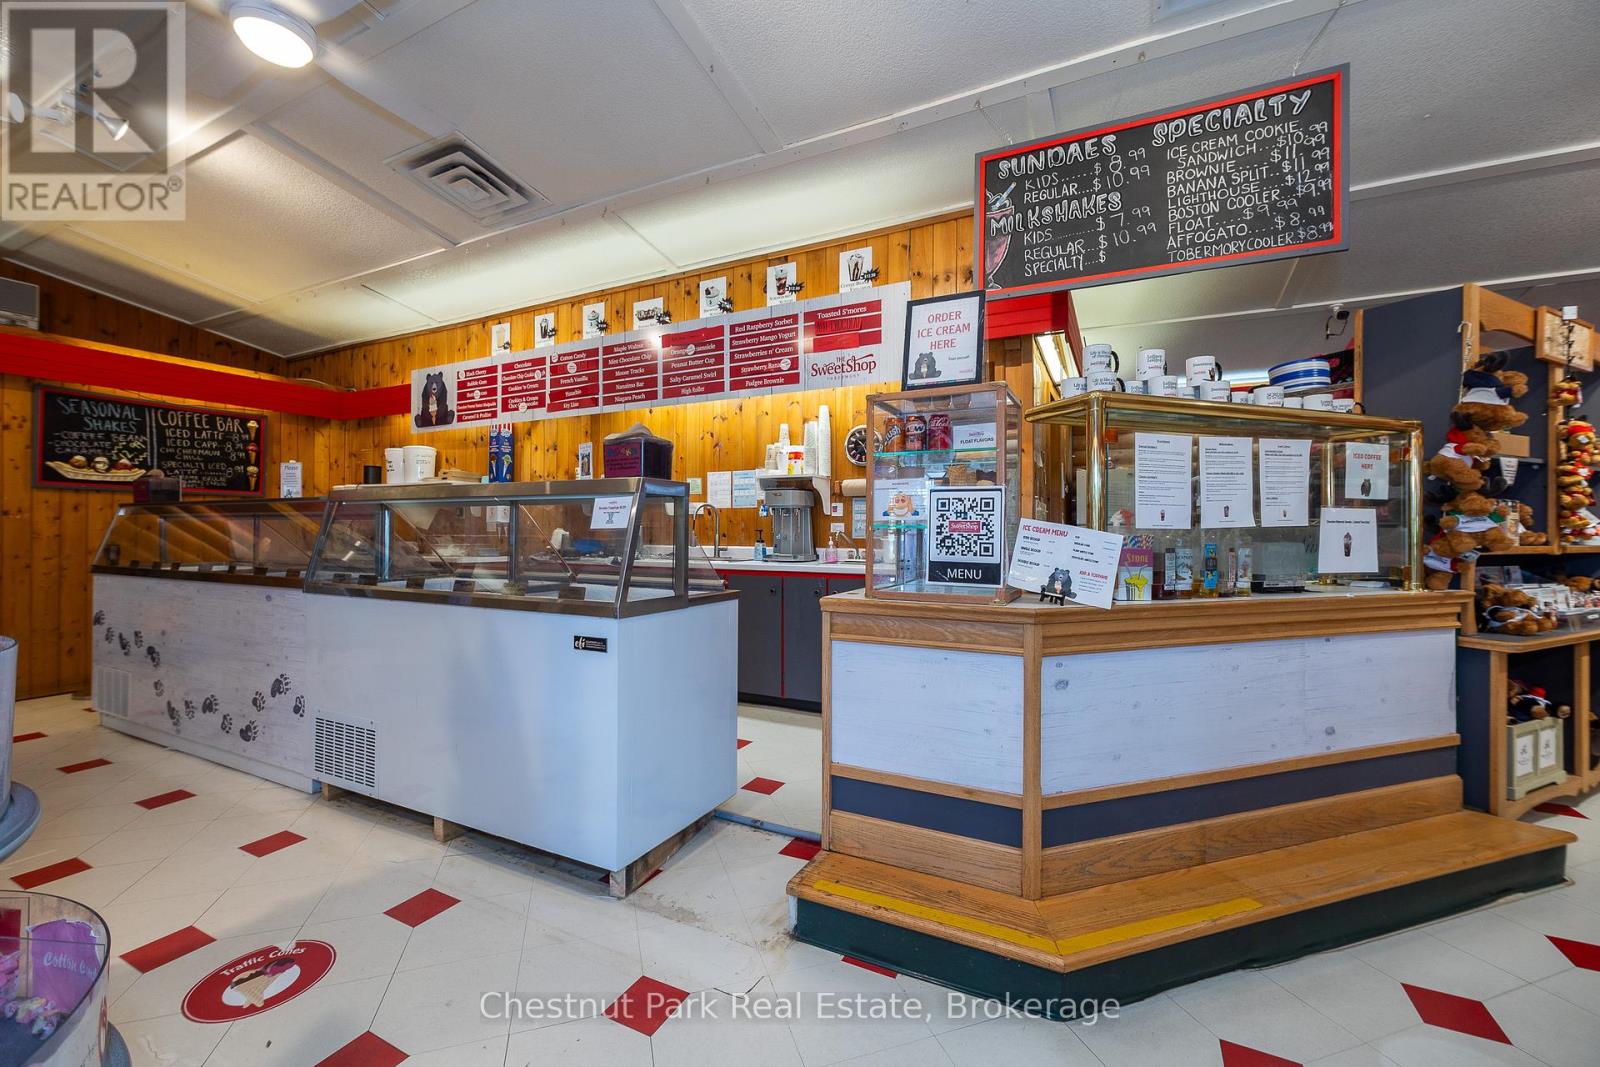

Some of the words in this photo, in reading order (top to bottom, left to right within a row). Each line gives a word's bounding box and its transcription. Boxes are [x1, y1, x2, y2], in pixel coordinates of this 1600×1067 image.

[1152, 89, 1311, 146] SPECIALTY
[1167, 144, 1188, 160] ICE
[1191, 134, 1238, 154] CREAM
[1244, 120, 1300, 142] COOKIE
[998, 134, 1117, 180] SUNDAES
[1177, 142, 1257, 169] SANDWICH
[1167, 160, 1236, 185] BROWNIE
[1167, 176, 1227, 198] BANANA
[1231, 165, 1270, 185] SPLIT
[1024, 182, 1078, 204] REGULAR
[1168, 181, 1260, 209] LIGHTHOUSE
[990, 191, 1122, 236] MILKSHAKES
[1168, 201, 1220, 223] BOSTON
[1226, 189, 1280, 210] COOLER
[1168, 215, 1214, 235] FLOAT
[1167, 223, 1248, 250] AFFOGATO
[1024, 238, 1085, 262] REGULAR
[1024, 254, 1083, 277] SPECIALTY
[817, 309, 841, 319] Toasted
[842, 305, 867, 315] S'mores
[927, 310, 962, 324] ORDER
[735, 325, 747, 333] Red
[748, 322, 774, 333] Raspberry
[775, 317, 793, 326] Sorbet
[917, 327, 932, 339] ICE
[935, 322, 971, 336] CREAM
[732, 336, 760, 347] Strawberry
[760, 333, 779, 344] Mango
[779, 331, 796, 341] Yogurt
[930, 338, 957, 350] HERE
[671, 361, 688, 369] Peanut
[688, 359, 704, 367] Butter
[704, 357, 715, 365] Cup
[734, 350, 768, 361] Strawberries
[775, 346, 794, 354] Cream
[682, 373, 703, 382] Caramel
[703, 371, 717, 379] Swirl
[741, 364, 768, 374] Strawberry
[763, 376, 785, 385] Brownie
[57, 397, 144, 420] SEASONAL
[83, 416, 137, 434] SHAKES
[157, 409, 211, 429] COFFEE
[216, 416, 244, 434] BAR
[165, 428, 191, 438] ICED
[194, 430, 224, 440] LATTE
[166, 439, 191, 447] ICED
[1051, 529, 1069, 538] MENU
[947, 568, 982, 579] MENU
[43, 951, 77, 972] Cotton
[220, 955, 265, 976] Traffic
